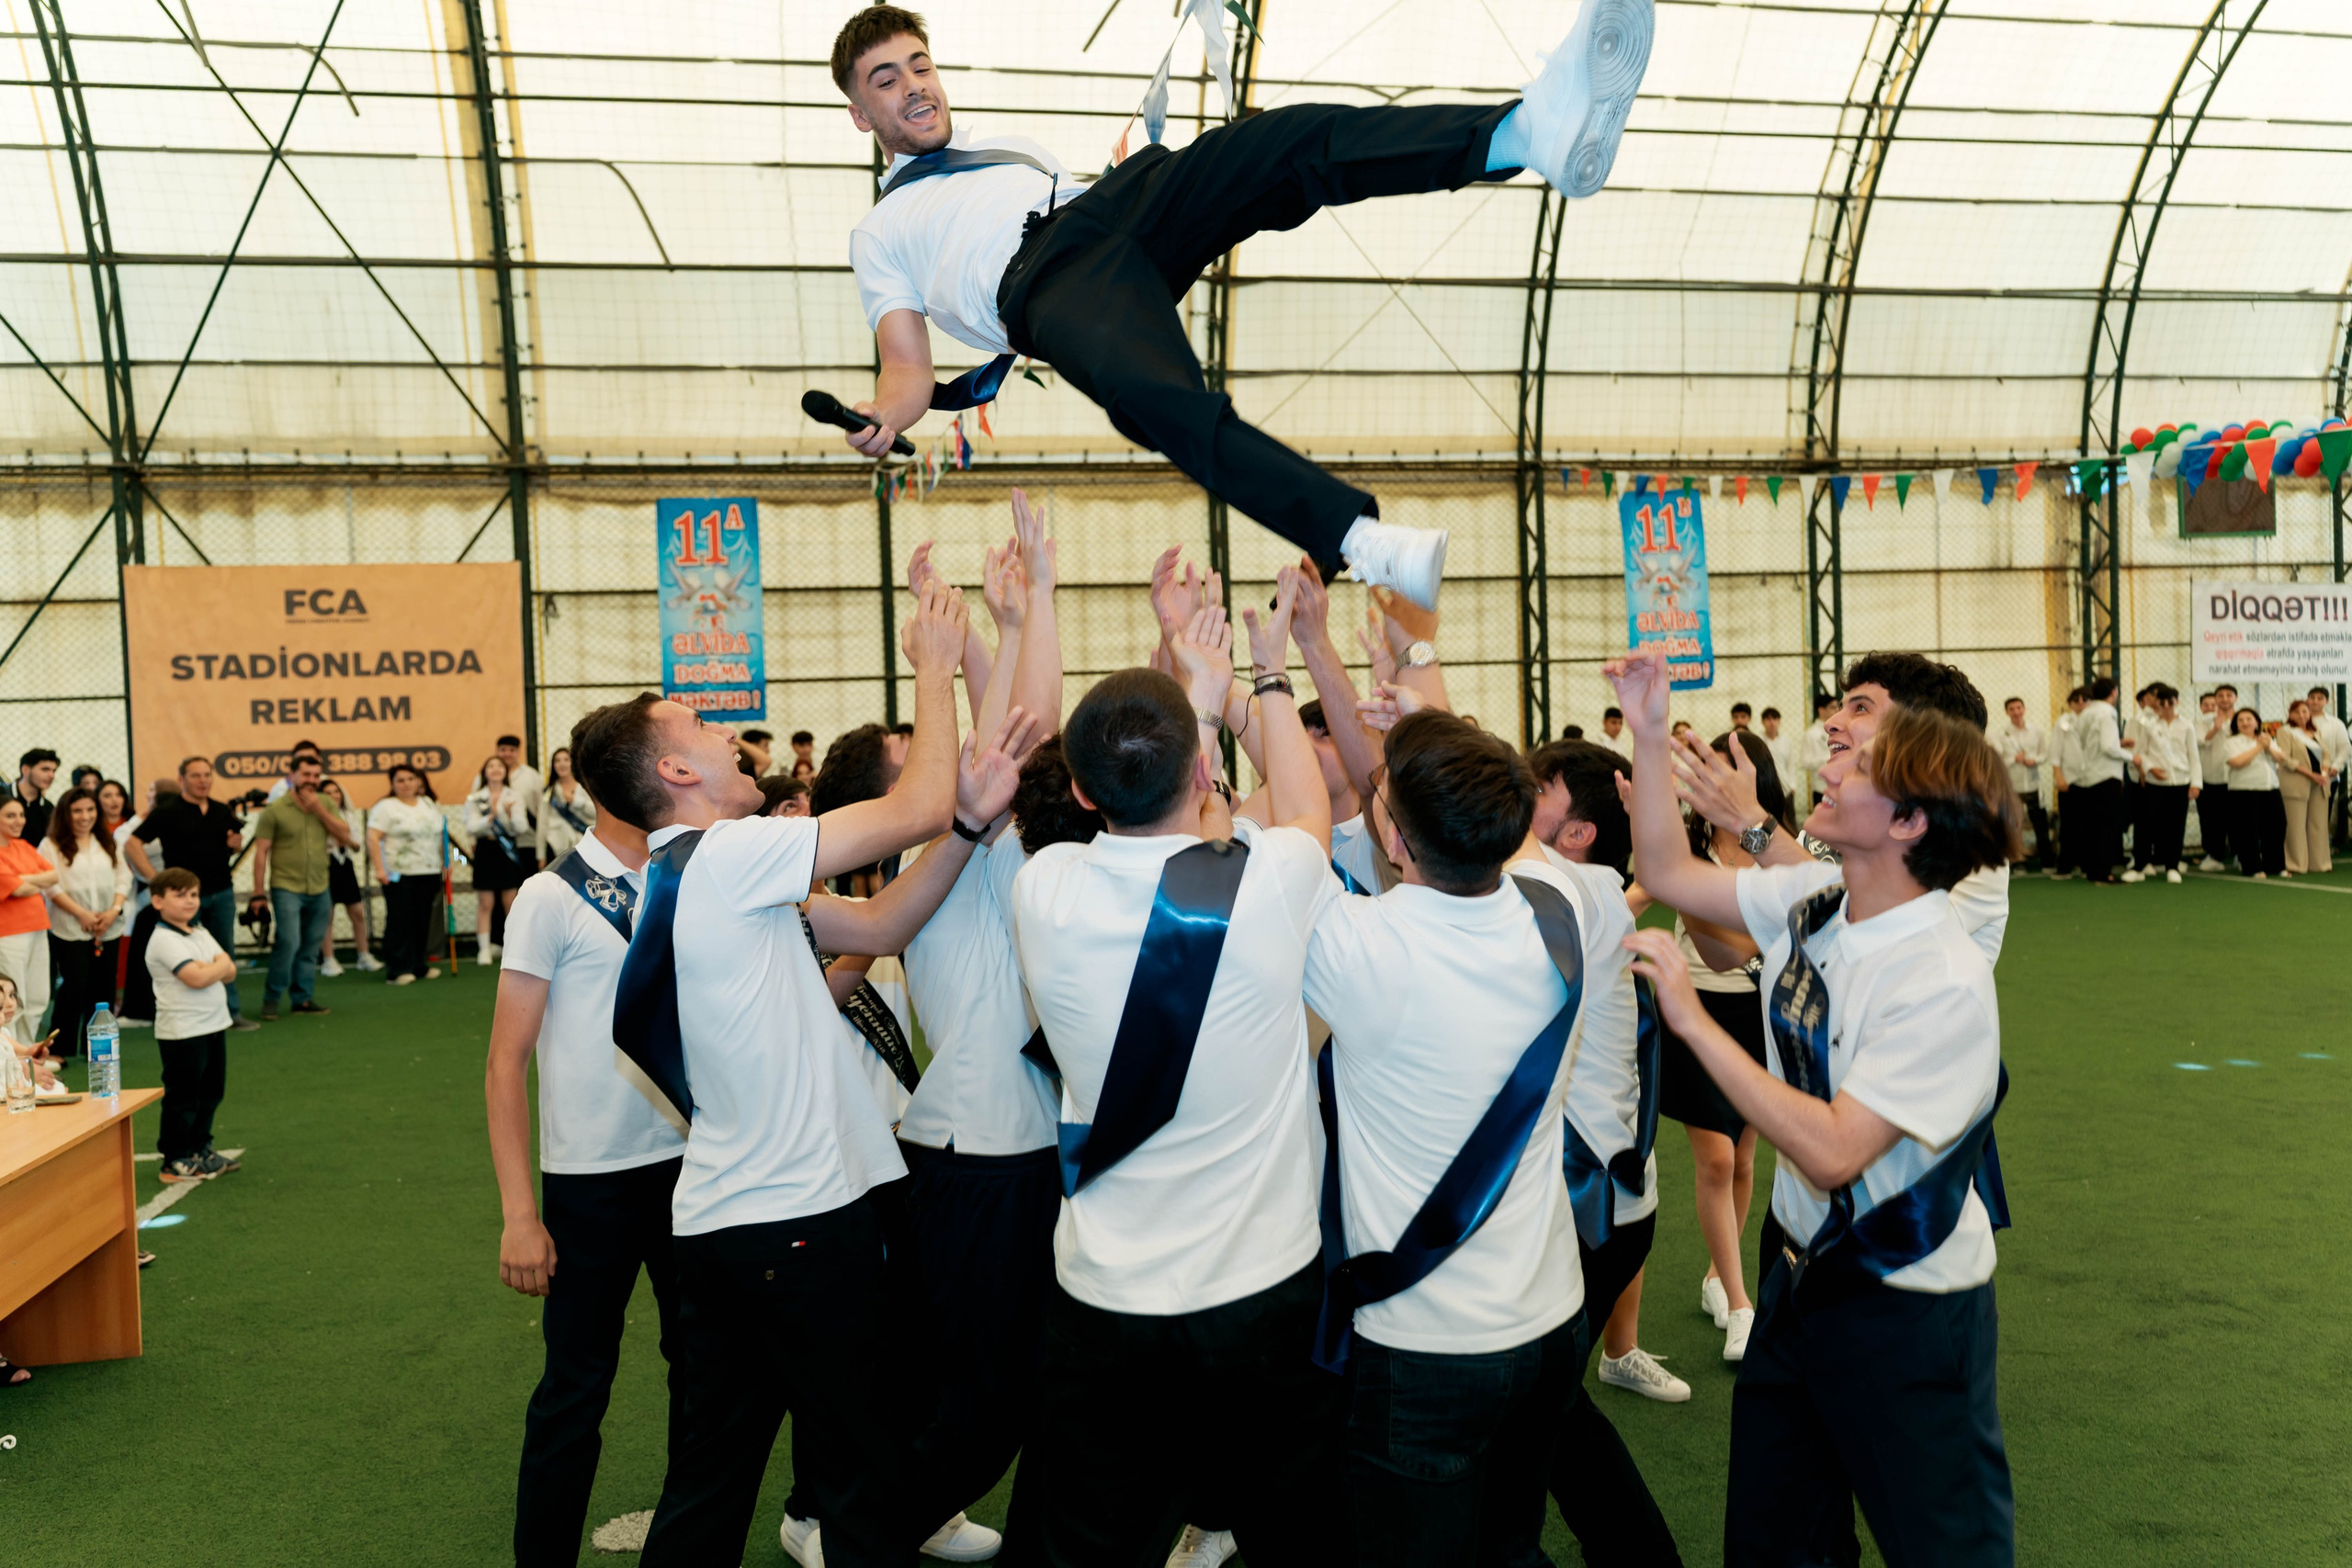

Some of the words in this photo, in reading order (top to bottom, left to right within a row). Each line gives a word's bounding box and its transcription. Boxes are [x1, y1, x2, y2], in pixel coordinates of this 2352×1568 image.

[285, 590, 368, 615] FCA
[2211, 590, 2348, 622] DİQQƏT!!!
[673, 631, 752, 656] ƏLVİDA
[171, 646, 483, 681] STADİONLARDA
[673, 659, 752, 685] DOĞMA
[2209, 663, 2241, 675] narahat
[251, 696, 412, 725] REKLAM
[327, 753, 373, 772] 388
[411, 750, 442, 770] 03
